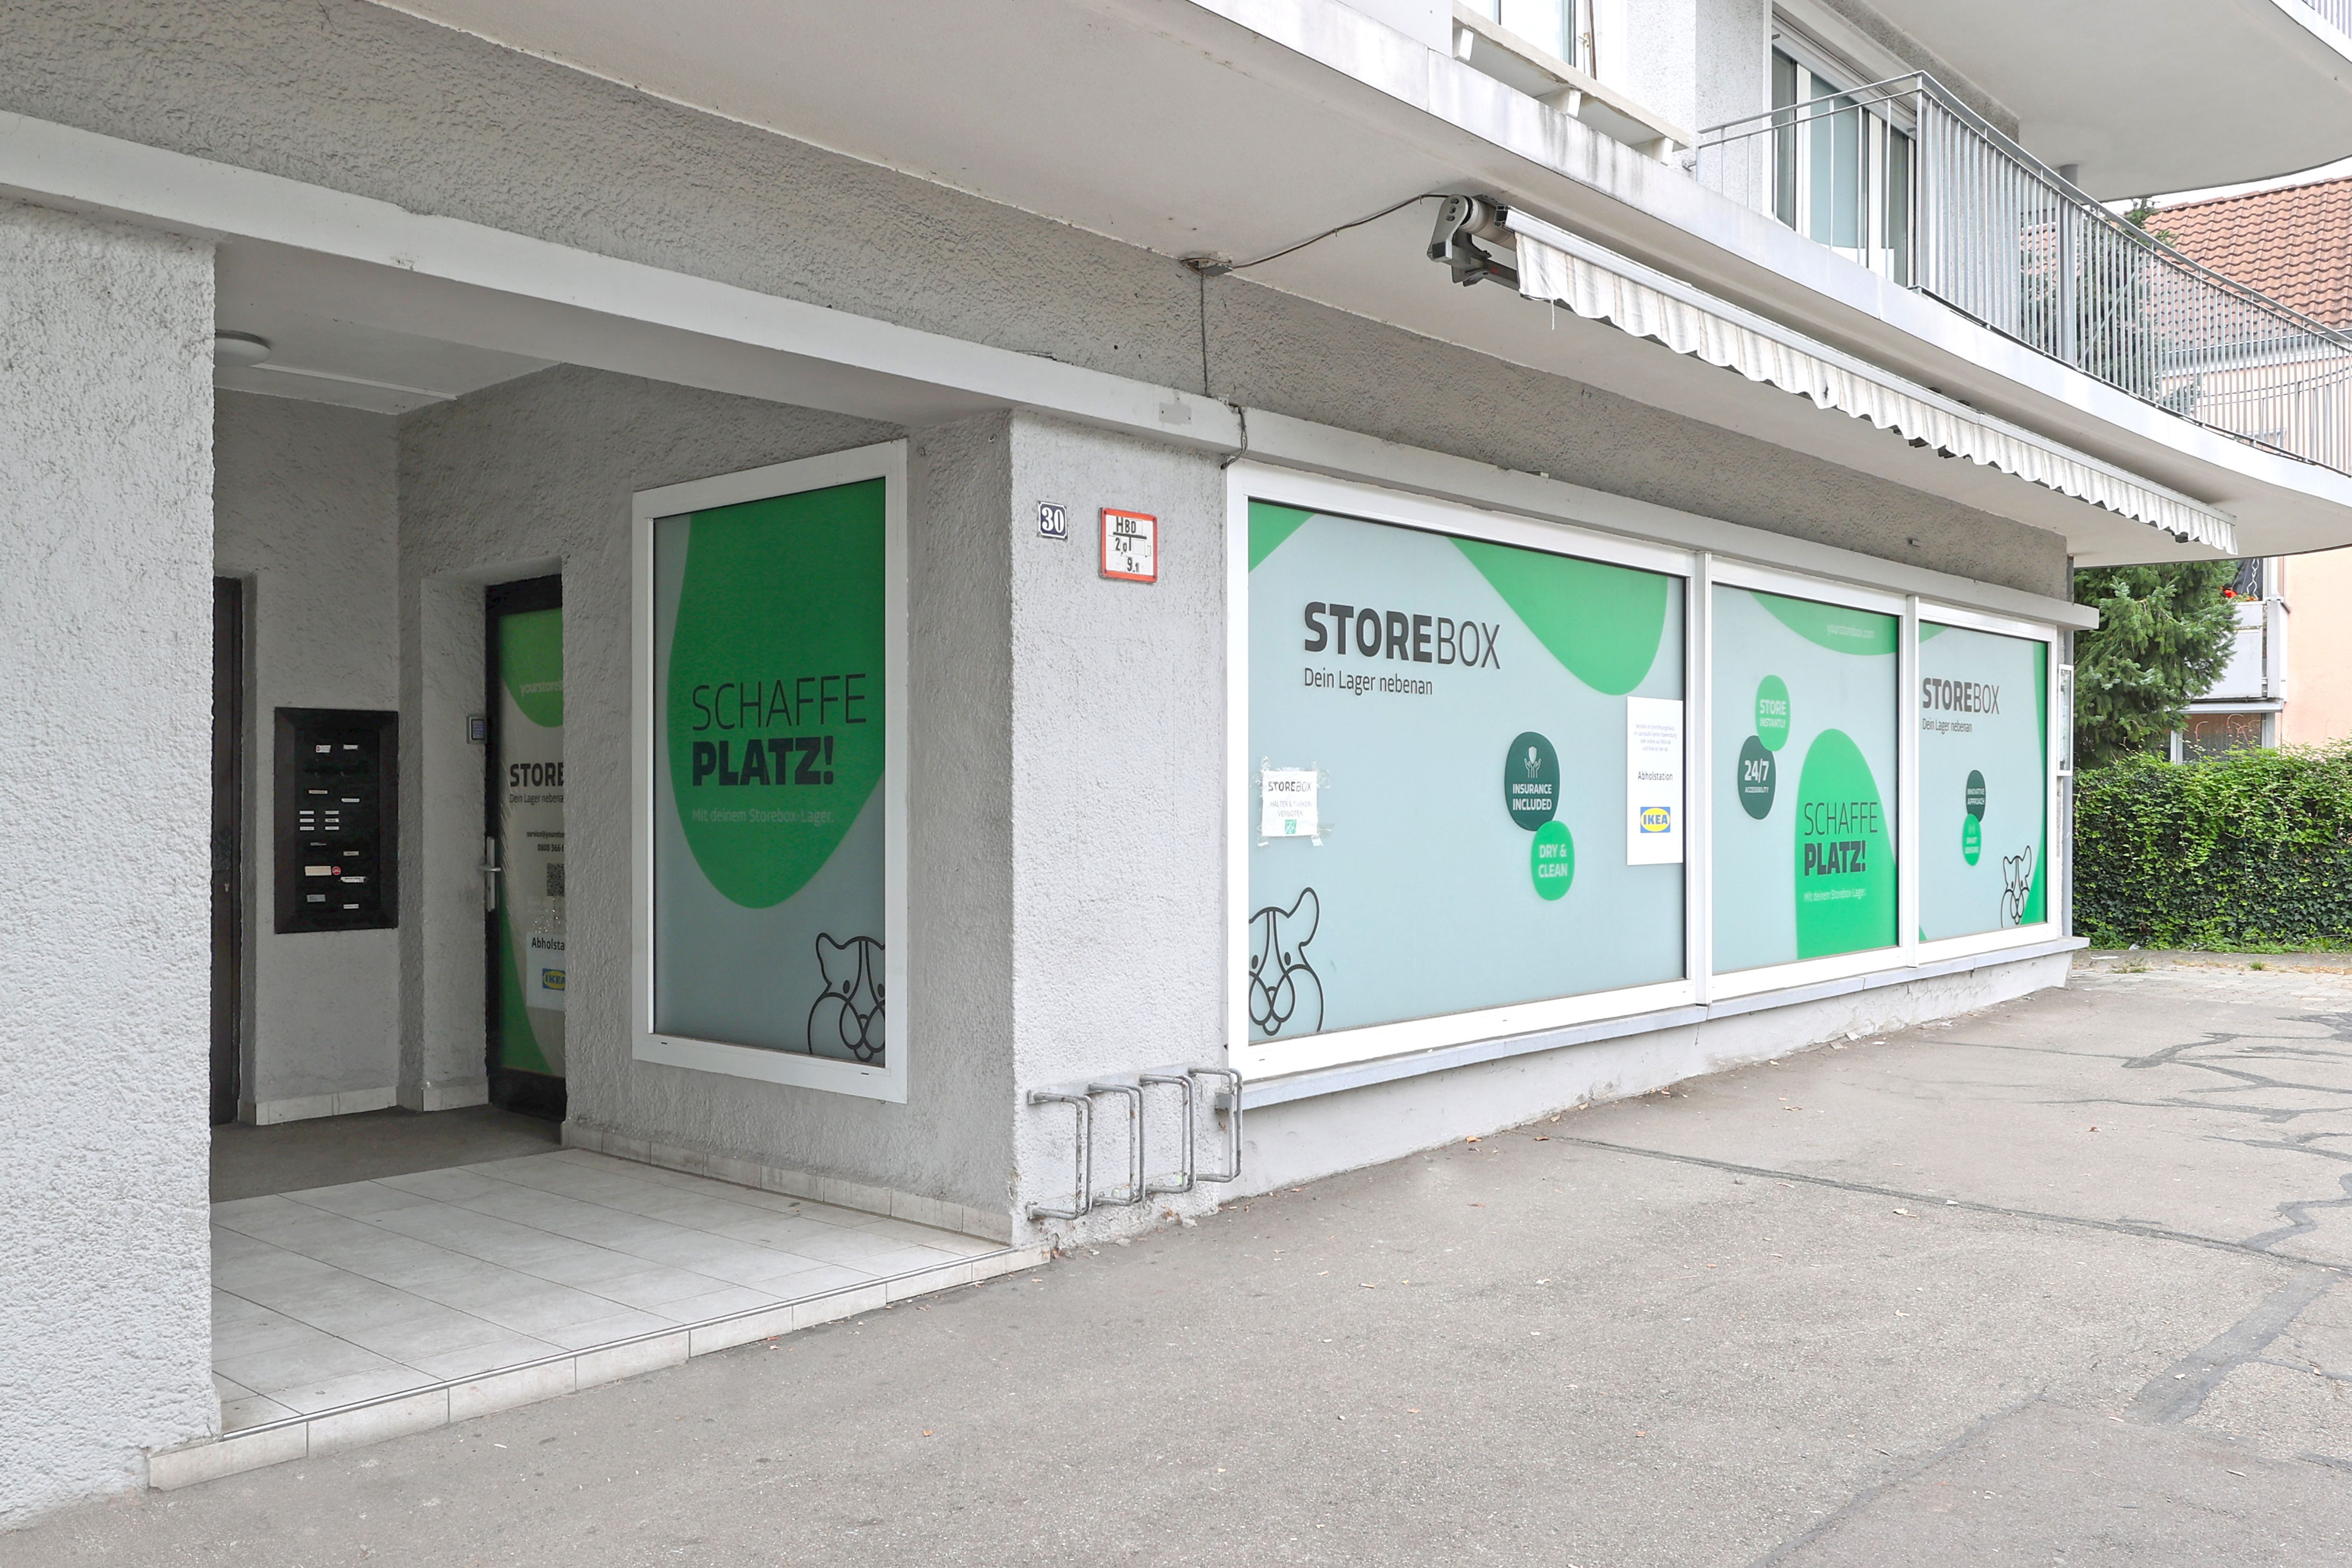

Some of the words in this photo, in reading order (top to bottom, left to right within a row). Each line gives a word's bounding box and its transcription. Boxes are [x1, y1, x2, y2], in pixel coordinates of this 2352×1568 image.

[1041, 507, 1064, 533] 30
[1305, 602, 1501, 669] STOREBOX
[1305, 668, 1334, 689] Dein
[1339, 670, 1375, 696] Lager
[1380, 673, 1432, 695] nebenan
[693, 673, 866, 731] SCHAFFE
[1923, 678, 2000, 714] STOREBOX
[1760, 699, 1786, 715] STORE
[1923, 718, 1934, 730] Dein
[1935, 719, 1950, 735] Lager
[1951, 720, 1972, 732] nebenan
[693, 736, 833, 786] PLATZ!
[510, 762, 563, 787] STORE
[1638, 771, 1673, 781] Abholstation
[1745, 758, 1769, 783] 24/7
[1268, 782, 1312, 792] STOREBOX
[1512, 784, 1553, 794] INSURANCE
[510, 793, 523, 803] Dein
[524, 794, 541, 805] Lager
[1513, 799, 1552, 811] INCLUDED
[692, 808, 708, 822] Mit
[710, 808, 746, 822] deinem
[1643, 814, 1668, 825] IKEA
[1804, 802, 1878, 836] SCHAFFE
[1539, 844, 1558, 858] DRY
[1560, 844, 1567, 858] &
[1804, 840, 1866, 876] PLATZ!
[1538, 863, 1568, 878] CLEAN
[531, 937, 565, 950] Abholsta
